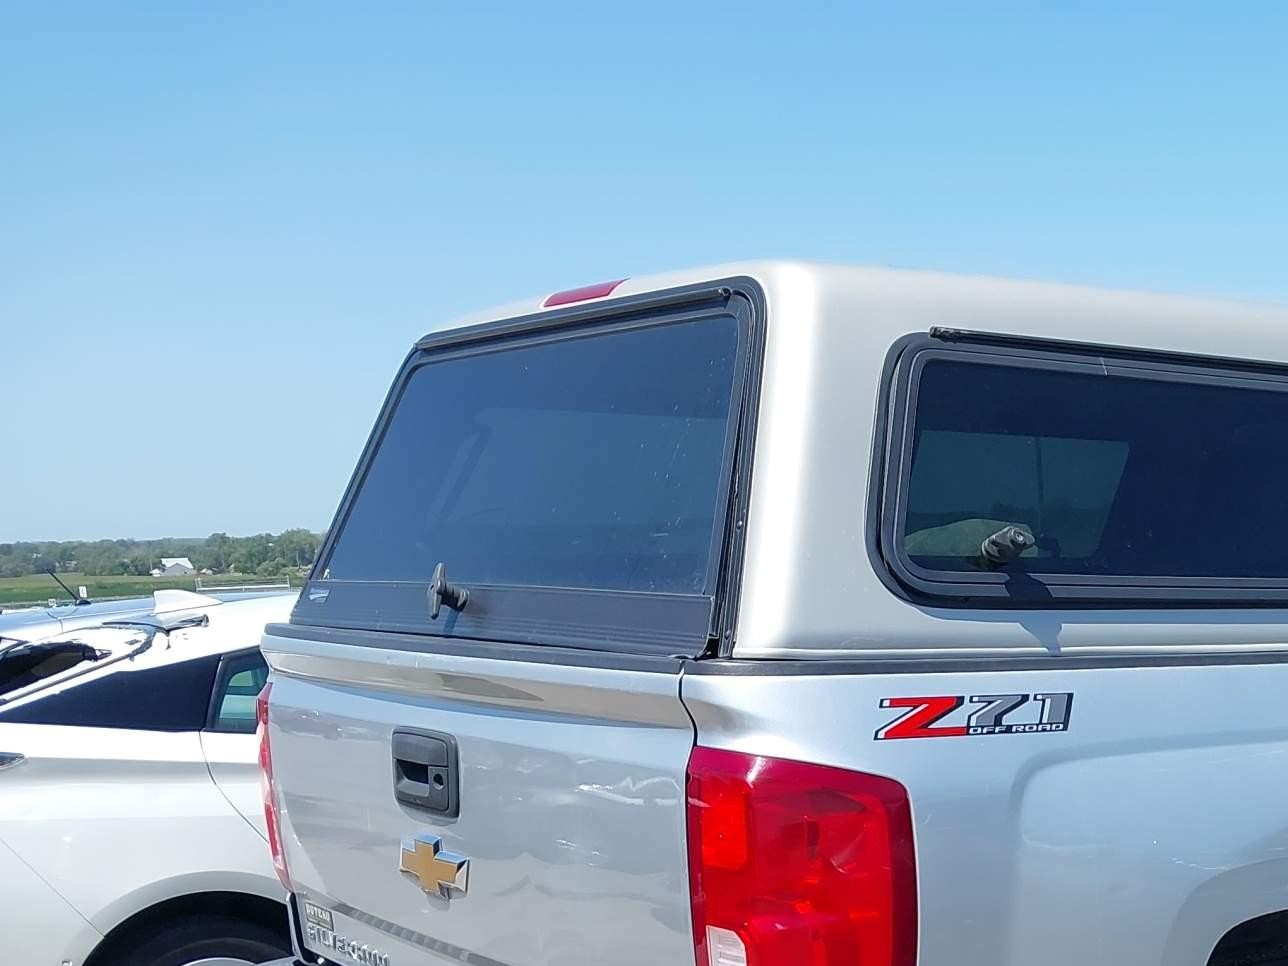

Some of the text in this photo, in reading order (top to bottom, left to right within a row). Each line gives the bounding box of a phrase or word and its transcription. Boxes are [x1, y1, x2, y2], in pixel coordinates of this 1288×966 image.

[874, 692, 1073, 740] Z71
[969, 723, 1062, 734] OFF ROAD
